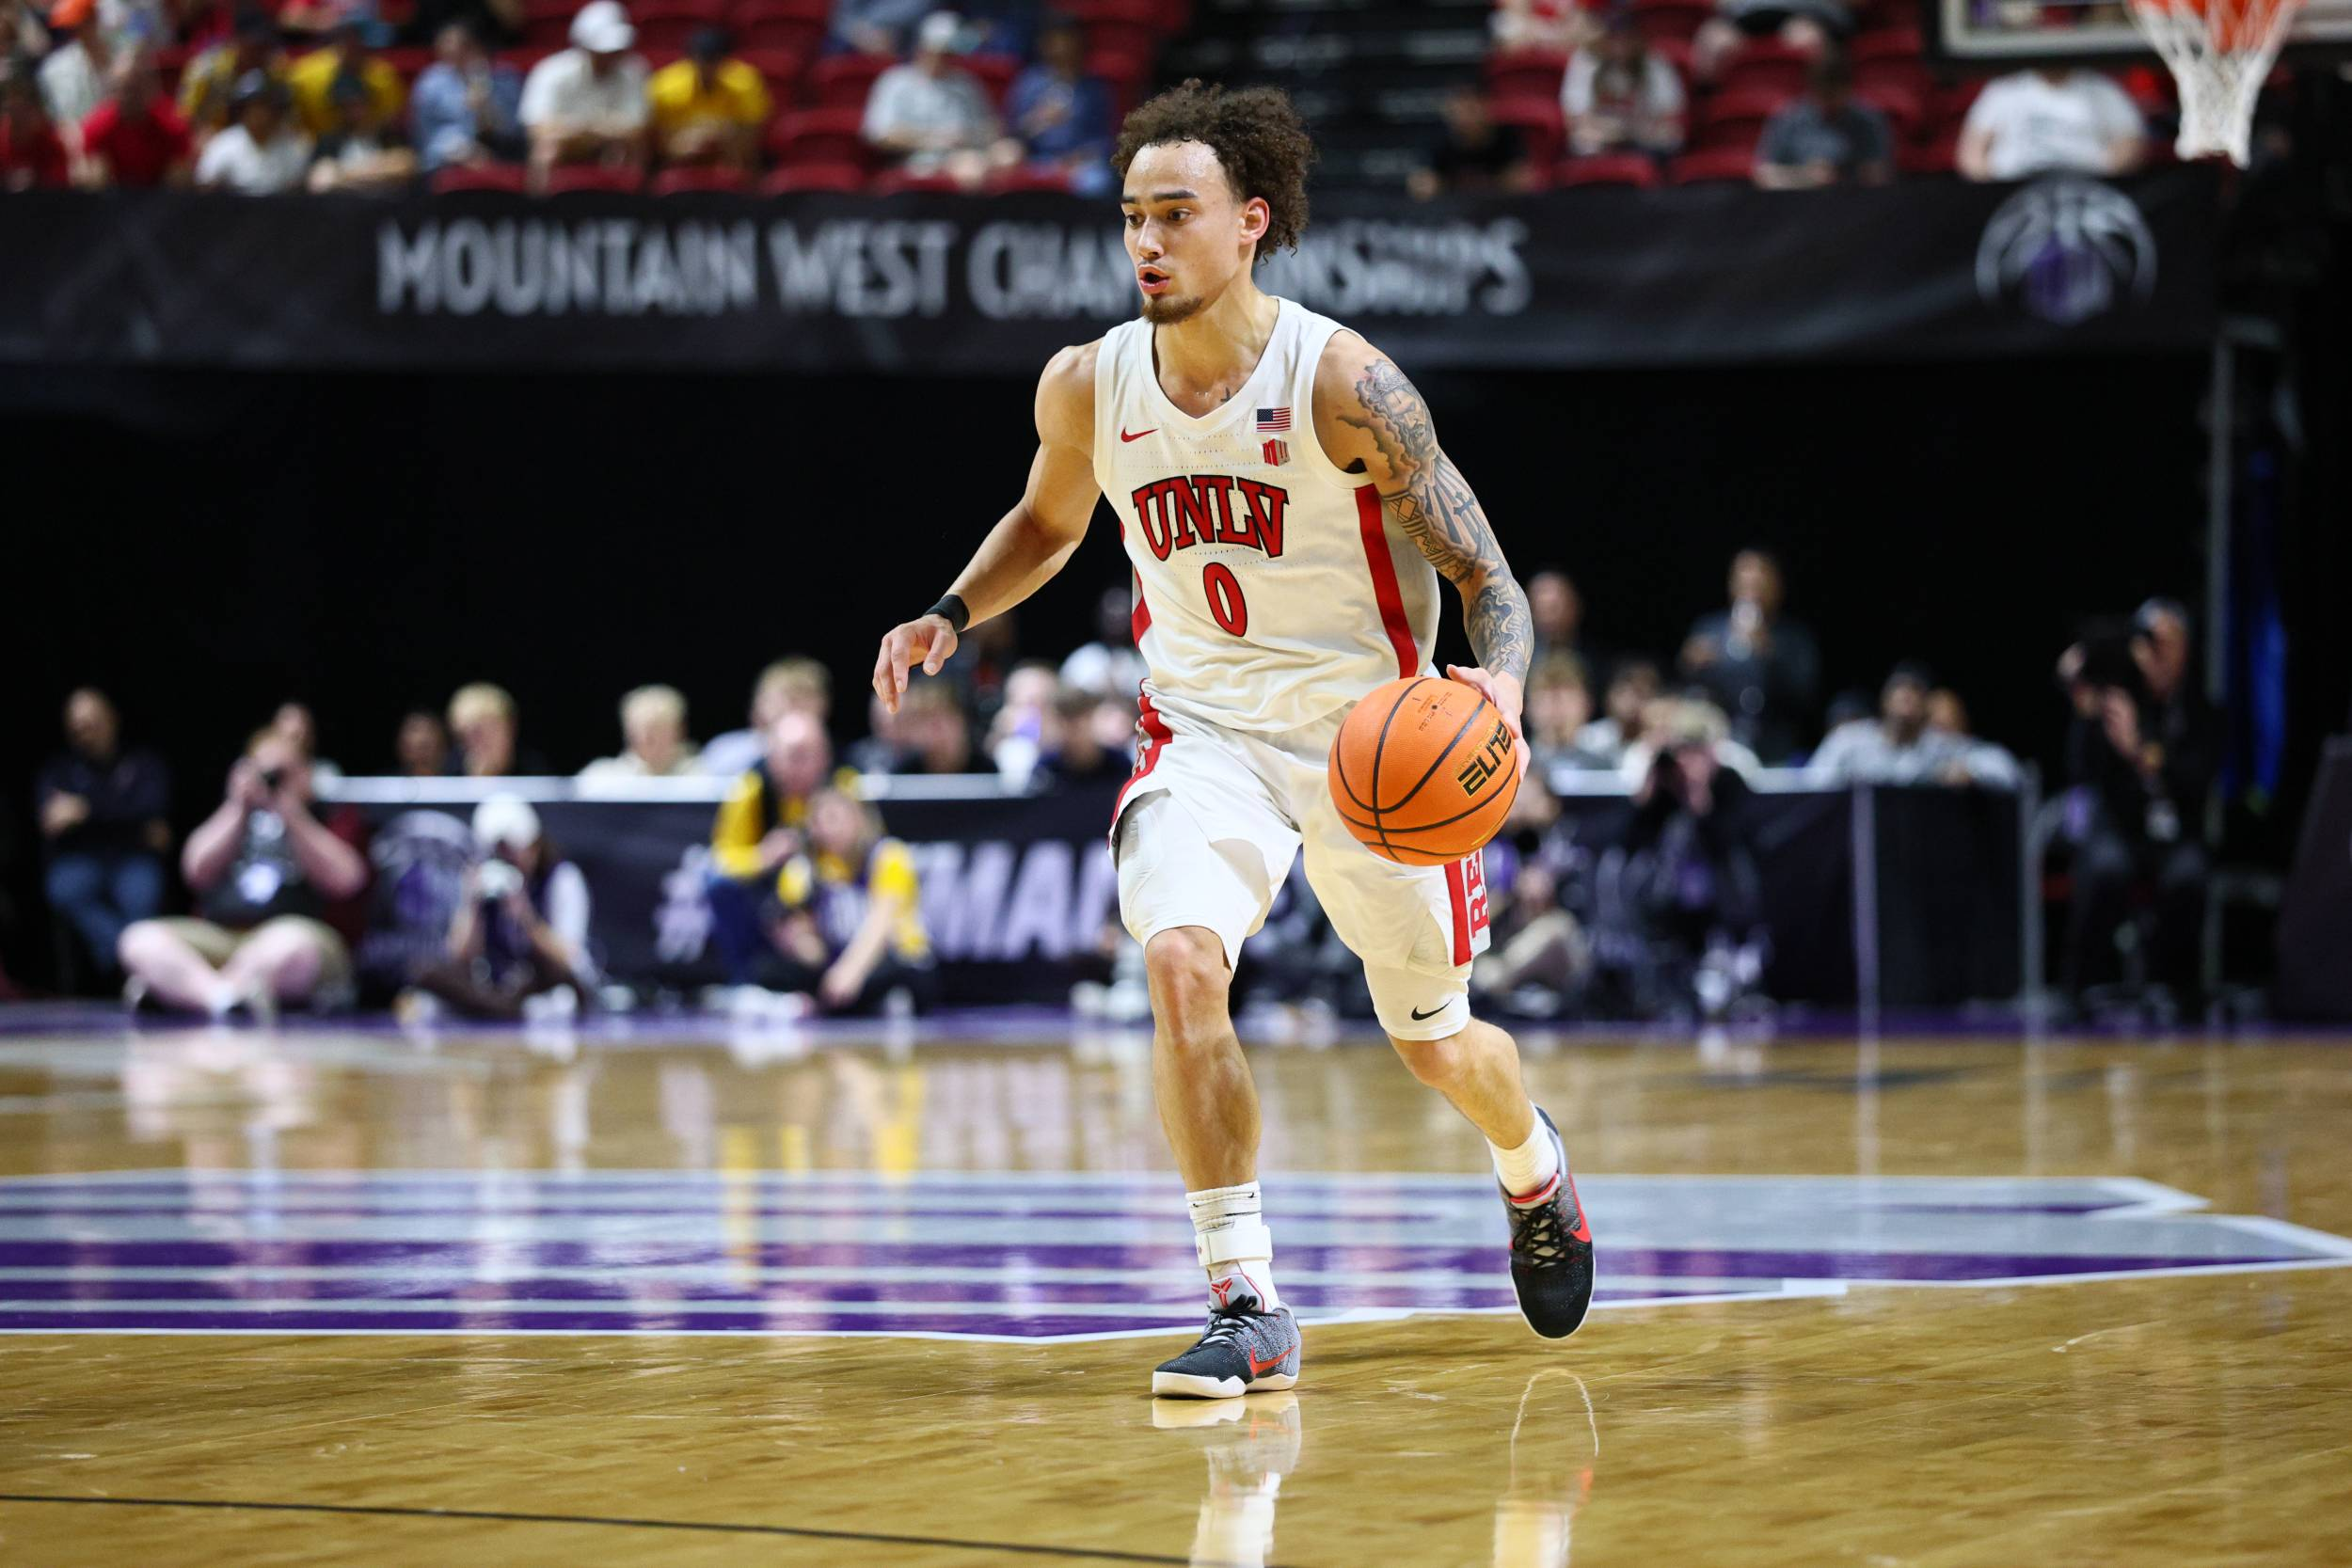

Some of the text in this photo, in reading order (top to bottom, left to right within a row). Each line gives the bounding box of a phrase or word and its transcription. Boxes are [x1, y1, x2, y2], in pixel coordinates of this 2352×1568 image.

[378, 219, 755, 315] MOUNTAIN
[767, 219, 960, 320] WEST
[1131, 474, 1290, 562] UNLV
[1203, 562, 1248, 638] 0
[1457, 720, 1512, 797] ELITE
